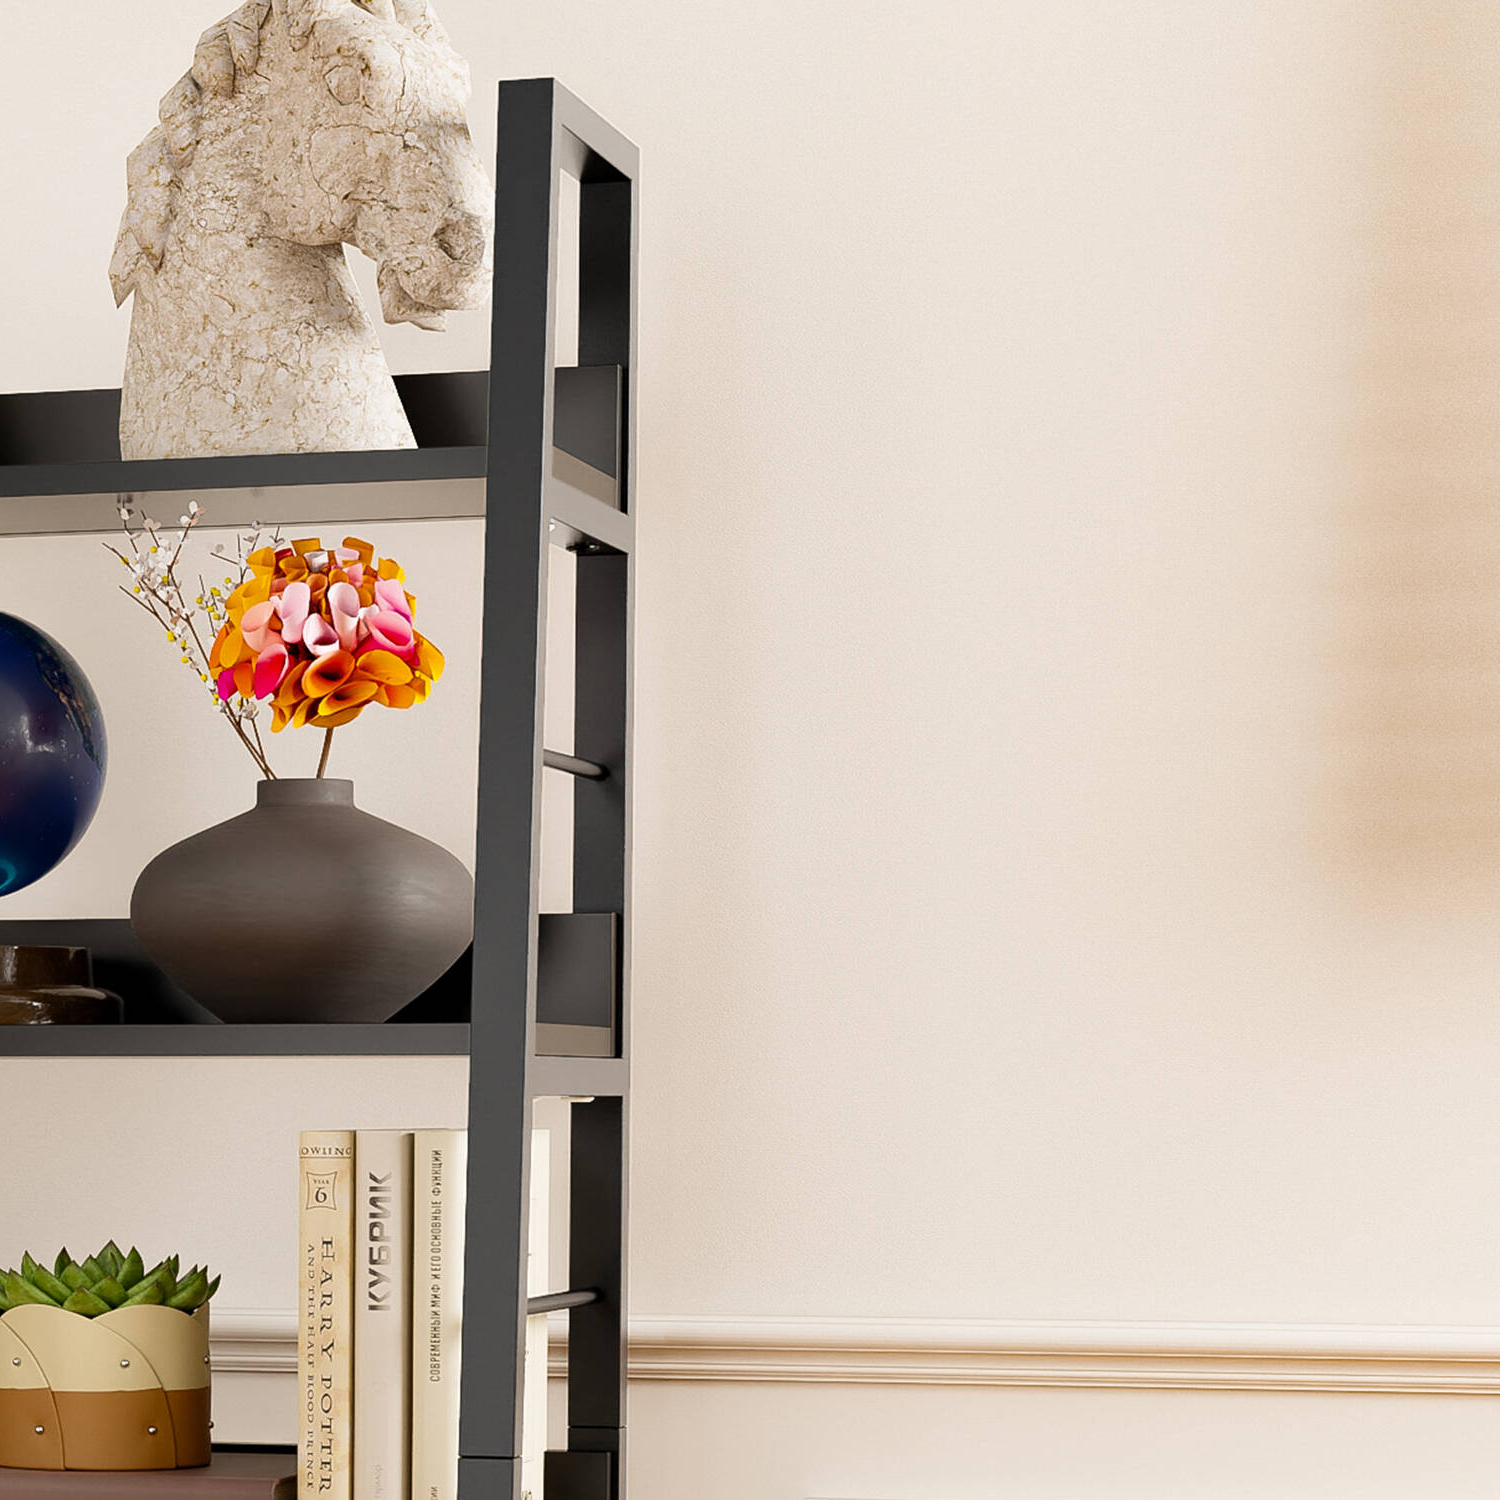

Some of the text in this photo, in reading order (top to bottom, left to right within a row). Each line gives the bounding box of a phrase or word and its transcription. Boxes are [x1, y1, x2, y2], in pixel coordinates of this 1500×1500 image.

[299, 1146, 351, 1156] OWLING
[430, 1149, 442, 1197] ФУНКЦИИ
[315, 1186, 327, 1203] 6
[368, 1171, 393, 1311] КУБРИК
[429, 1201, 441, 1254] ОСНОВНЫЕ
[307, 1244, 315, 1279] AND
[430, 1255, 441, 1272] ЕГО
[307, 1286, 315, 1318] THE
[429, 1283, 441, 1308] МИФ
[319, 1236, 335, 1494] HARRY POTTER
[306, 1375, 315, 1423] BLOOD
[306, 1430, 314, 1488] PRINCE
